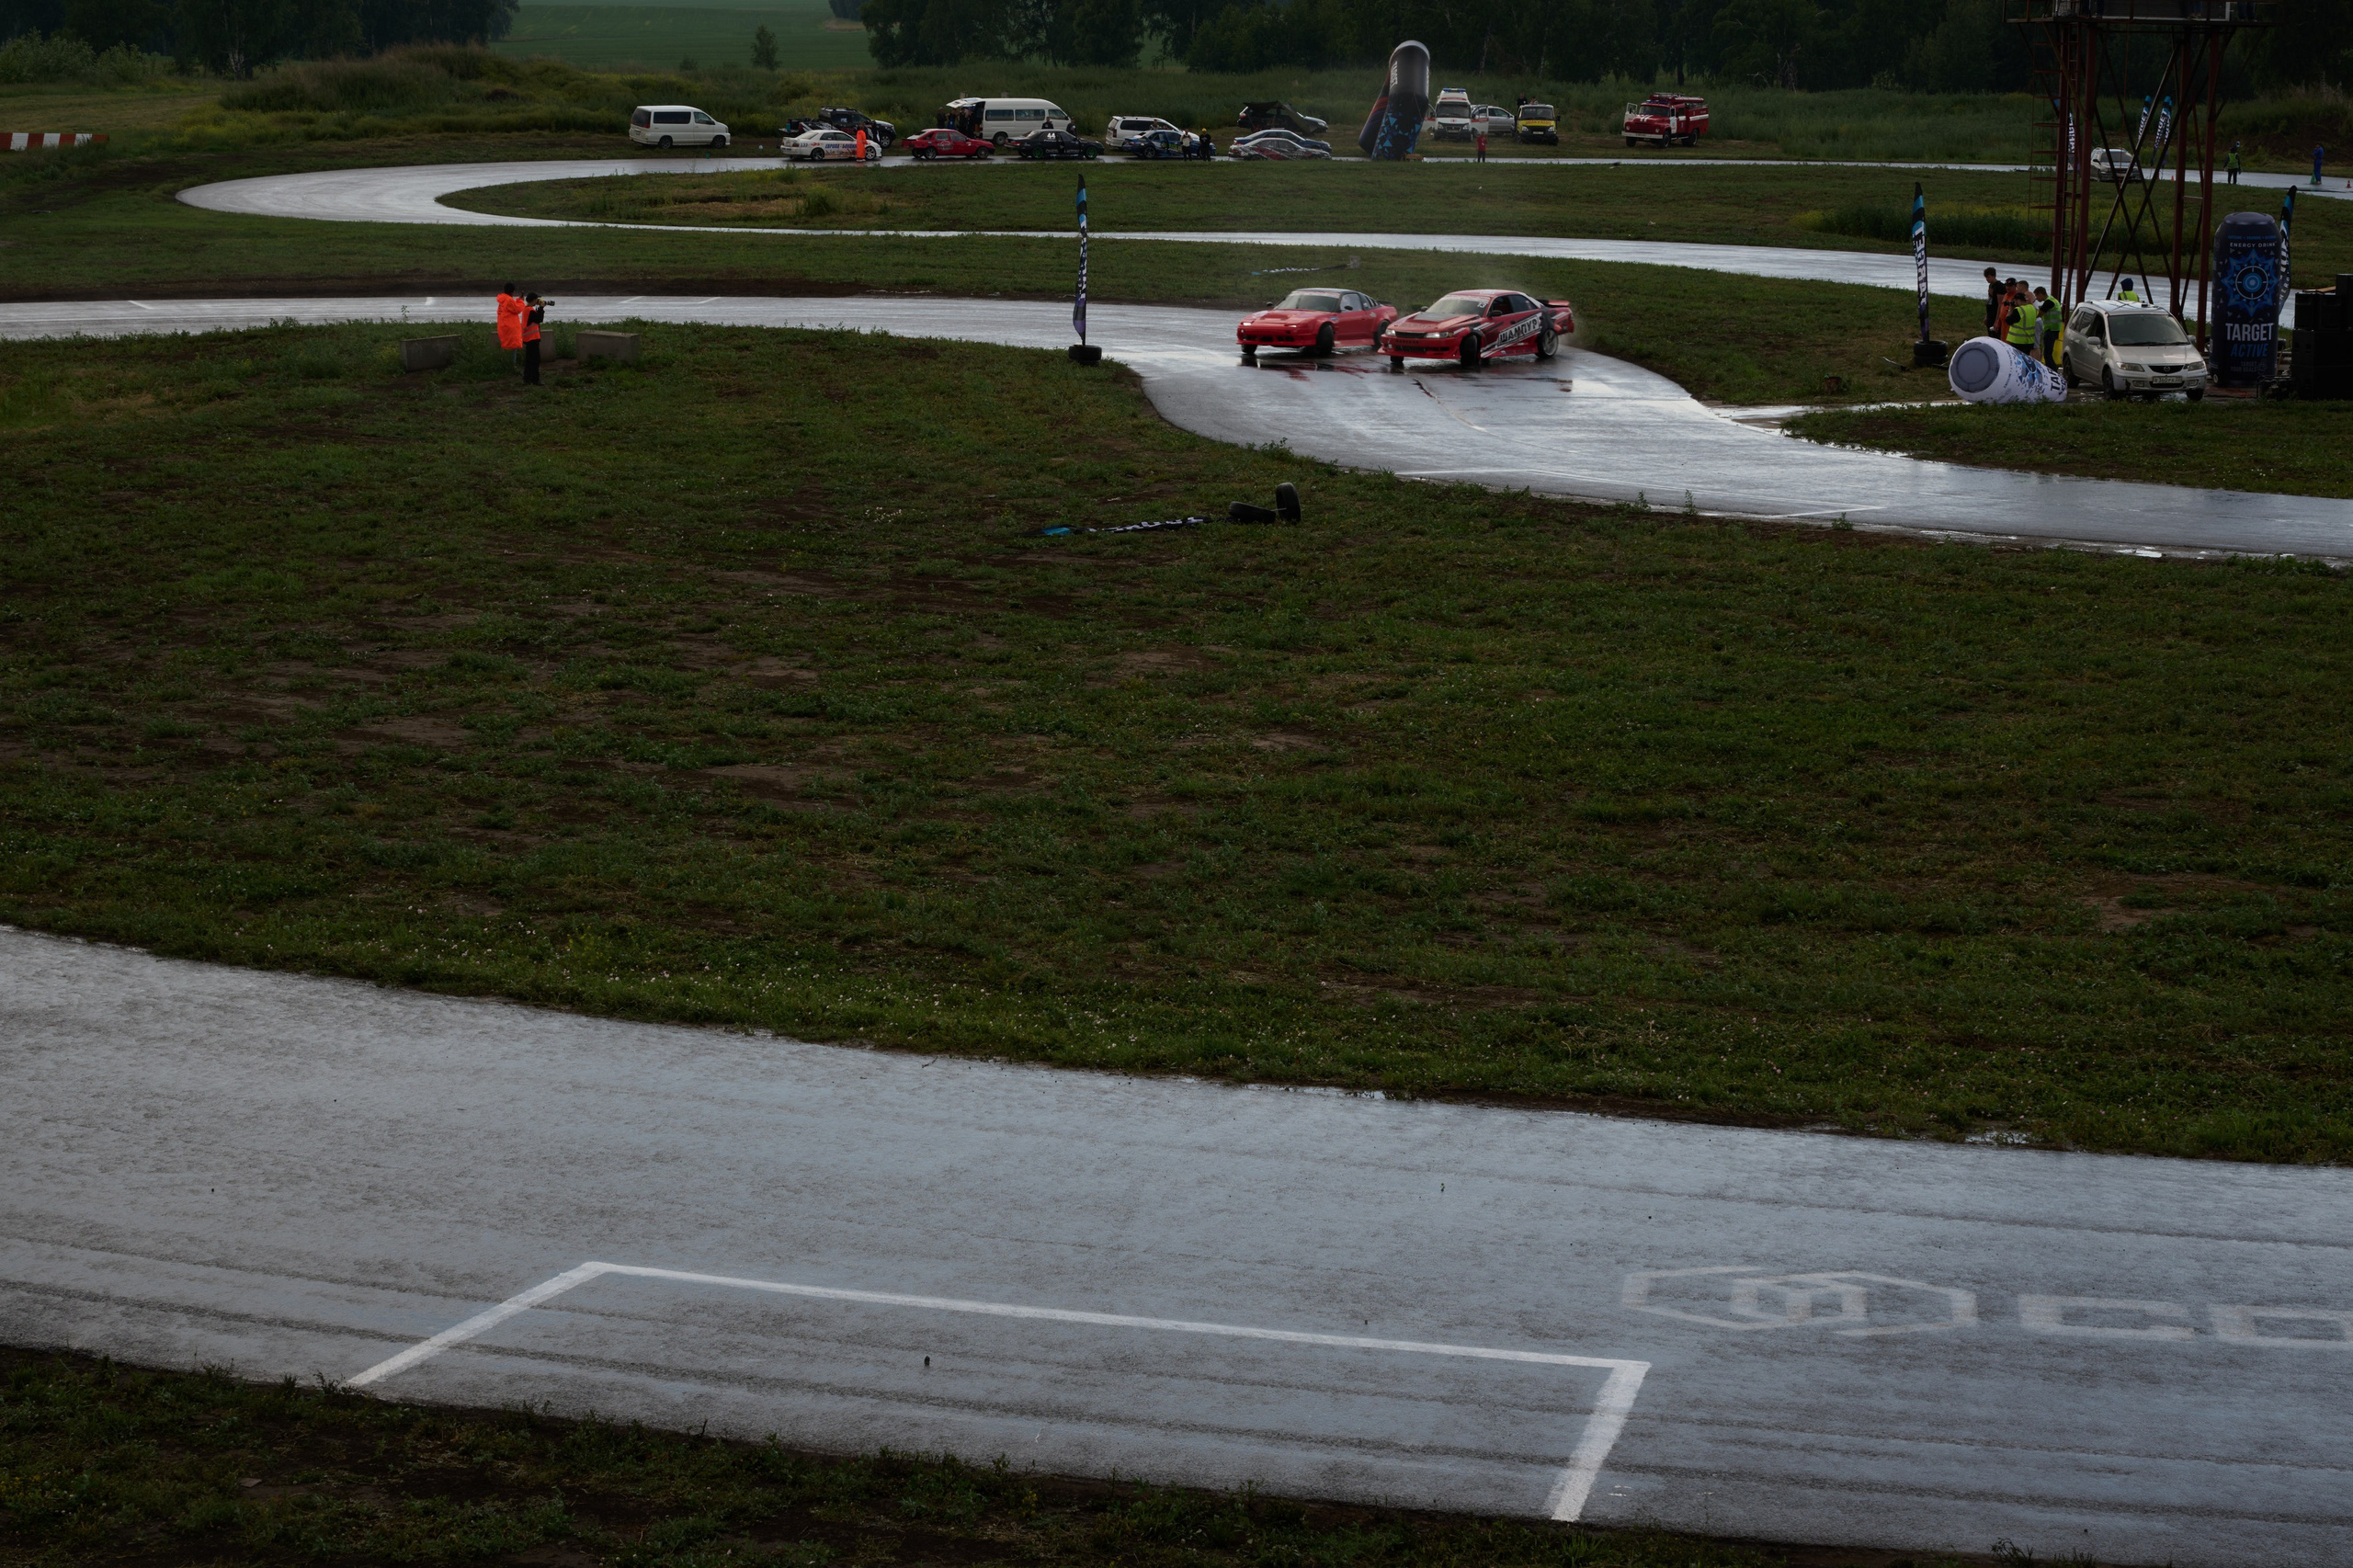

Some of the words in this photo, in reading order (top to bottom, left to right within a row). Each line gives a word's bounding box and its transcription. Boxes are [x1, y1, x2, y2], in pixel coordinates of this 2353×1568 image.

[1500, 319, 1538, 342] ШАМПУР
[2225, 323, 2275, 341] TARGET
[2230, 343, 2269, 358] ACTIVE
